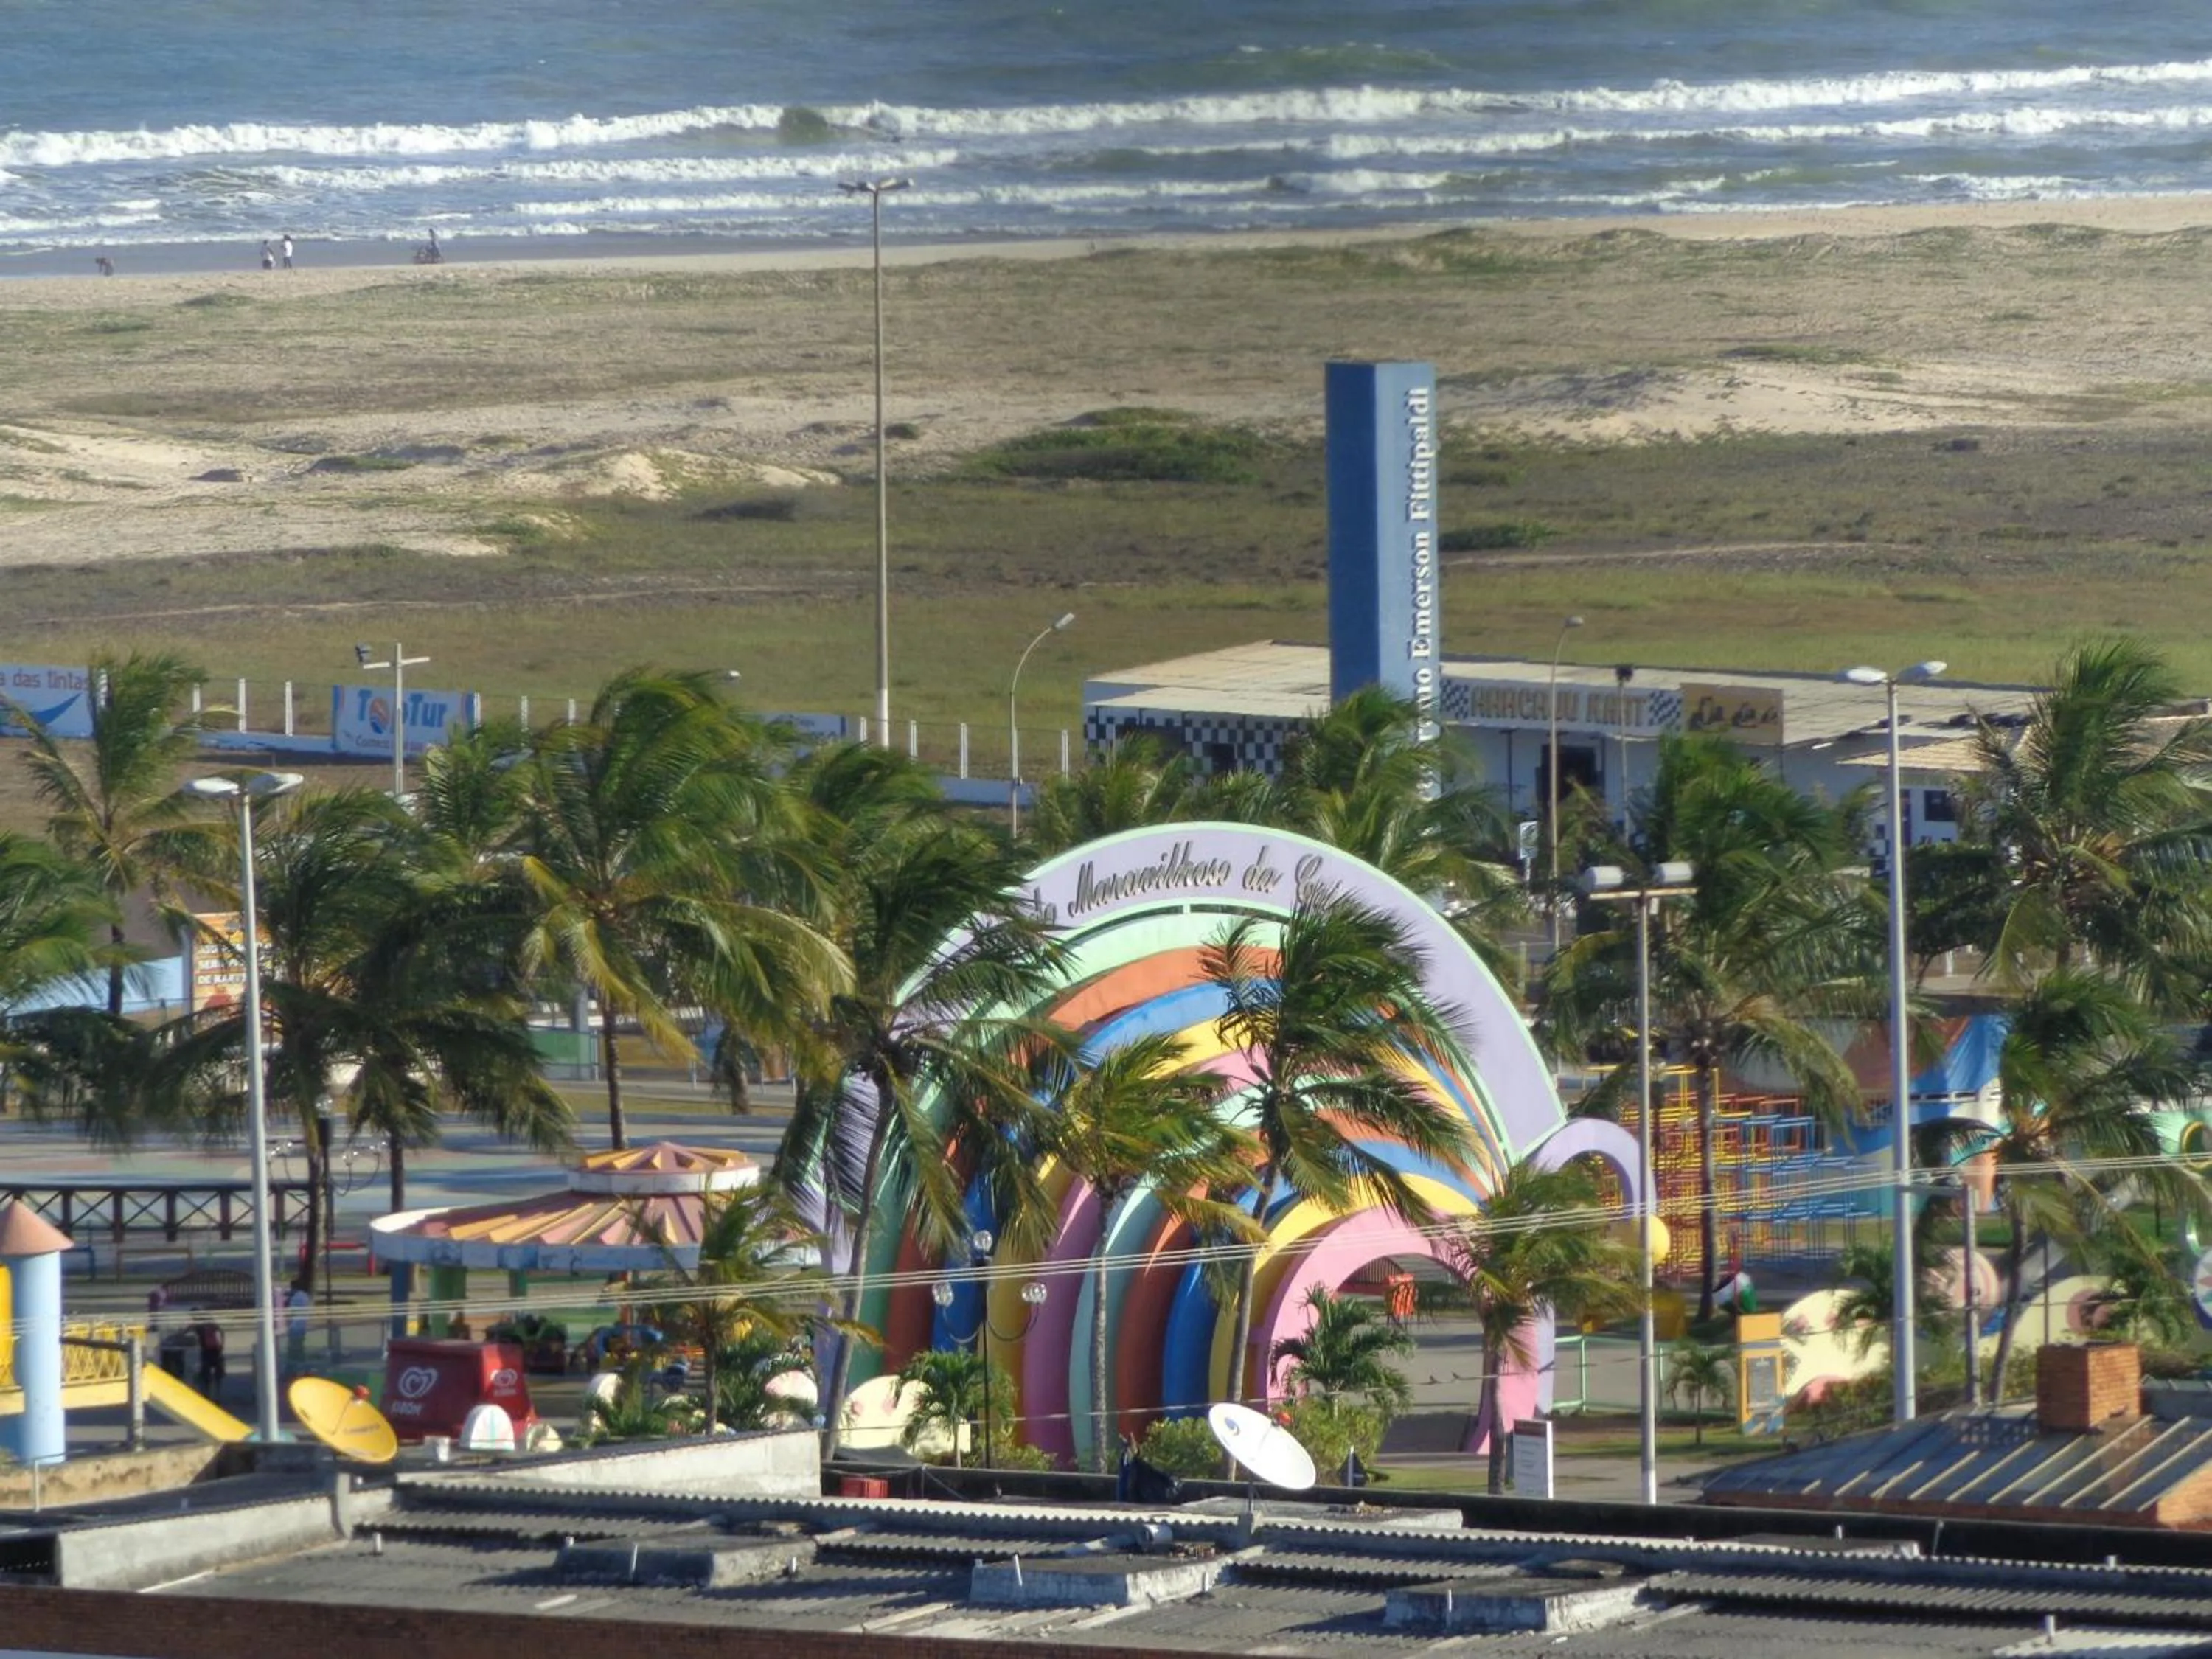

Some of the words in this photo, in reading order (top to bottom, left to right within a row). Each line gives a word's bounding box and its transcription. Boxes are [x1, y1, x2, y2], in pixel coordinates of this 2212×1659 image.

[1410, 386, 1435, 523] Fittipaldi
[1411, 530, 1432, 659] Emerson
[1068, 840, 1231, 918] Maravilhoso
[1242, 845, 1284, 894] da
